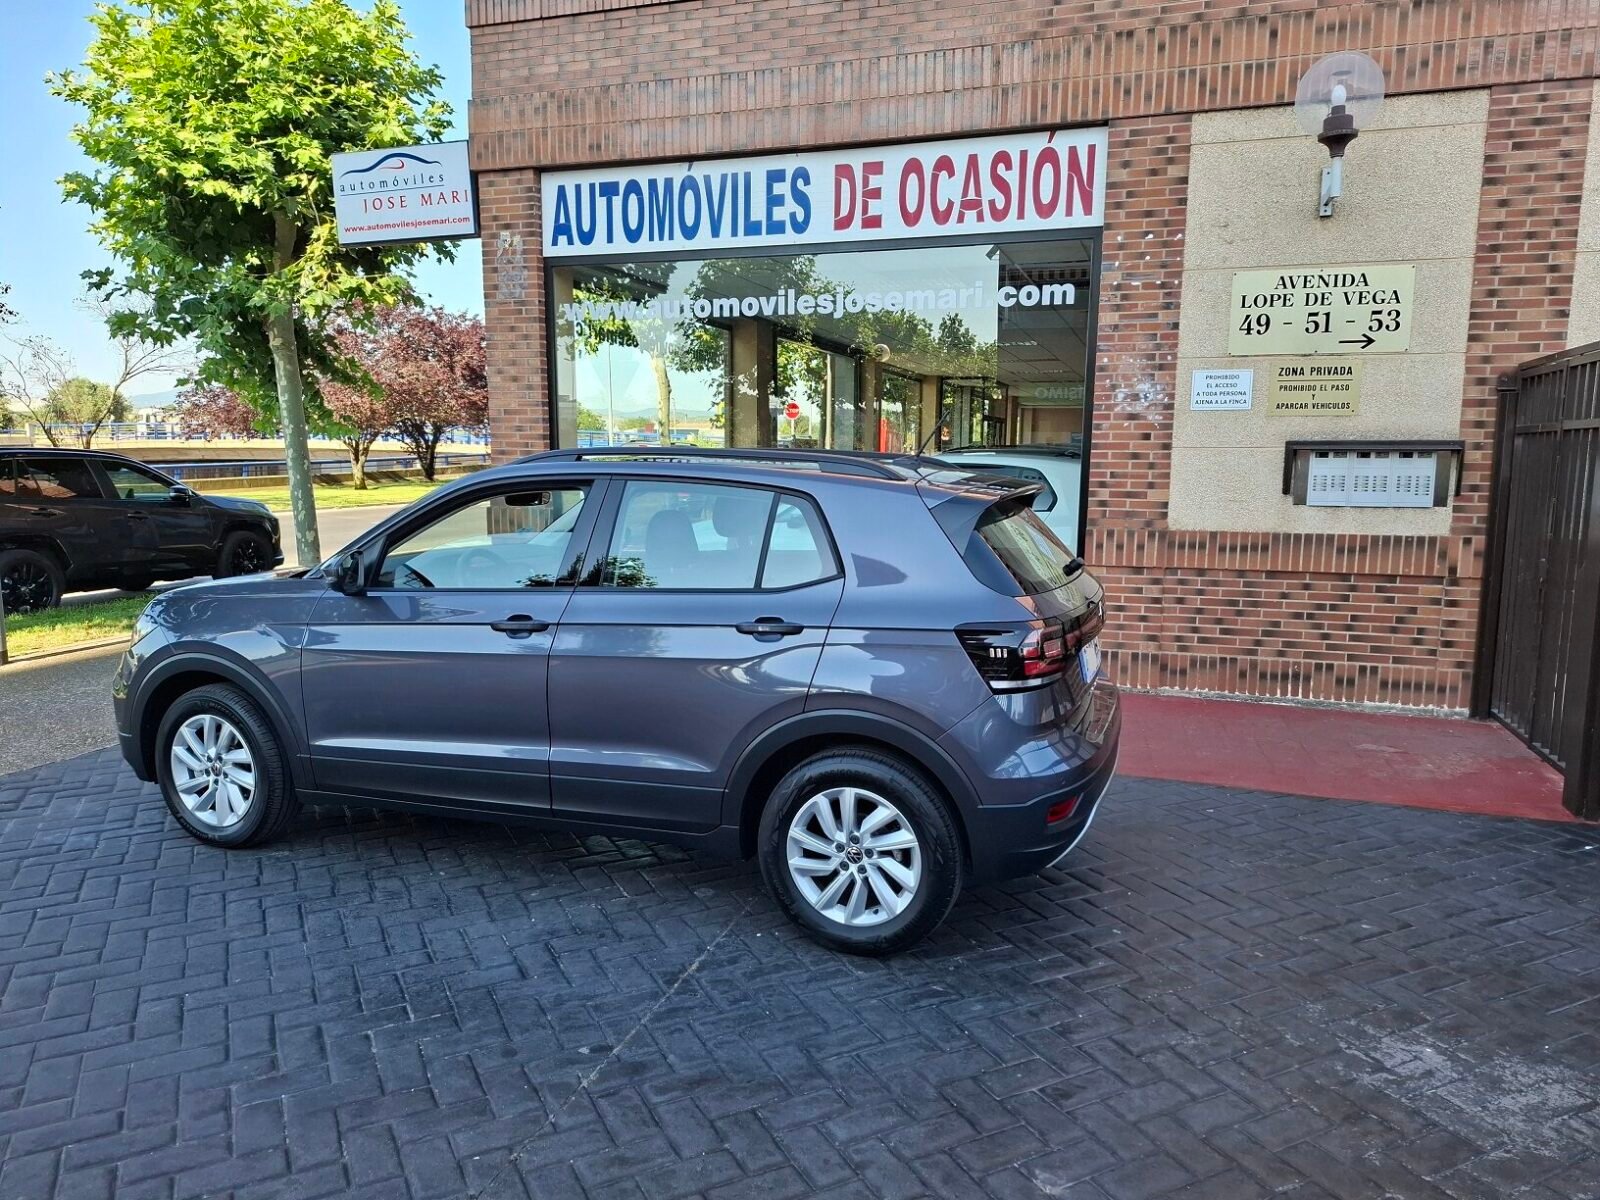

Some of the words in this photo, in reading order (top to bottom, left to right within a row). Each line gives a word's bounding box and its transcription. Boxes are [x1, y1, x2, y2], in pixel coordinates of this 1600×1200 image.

[339, 174, 445, 192] automóviles
[551, 162, 811, 246] AUTOMÓVILES
[834, 161, 884, 231] DE
[898, 130, 1097, 228] OCASIÓN
[363, 196, 408, 213] JOSE
[420, 190, 468, 207] MARI
[344, 216, 471, 233] www.automovilesjosemari.com
[1274, 272, 1370, 290] AVENIDA
[1240, 294, 1294, 309] LOPE
[1304, 292, 1333, 307] DE
[1343, 290, 1401, 305] VEGA
[1239, 313, 1271, 336] 49
[1305, 312, 1333, 334] 51
[1368, 309, 1401, 333] 53
[1278, 367, 1305, 377] ZONA
[1310, 366, 1353, 376] PRIVADA
[1279, 384, 1317, 392] PROHIBIDO
